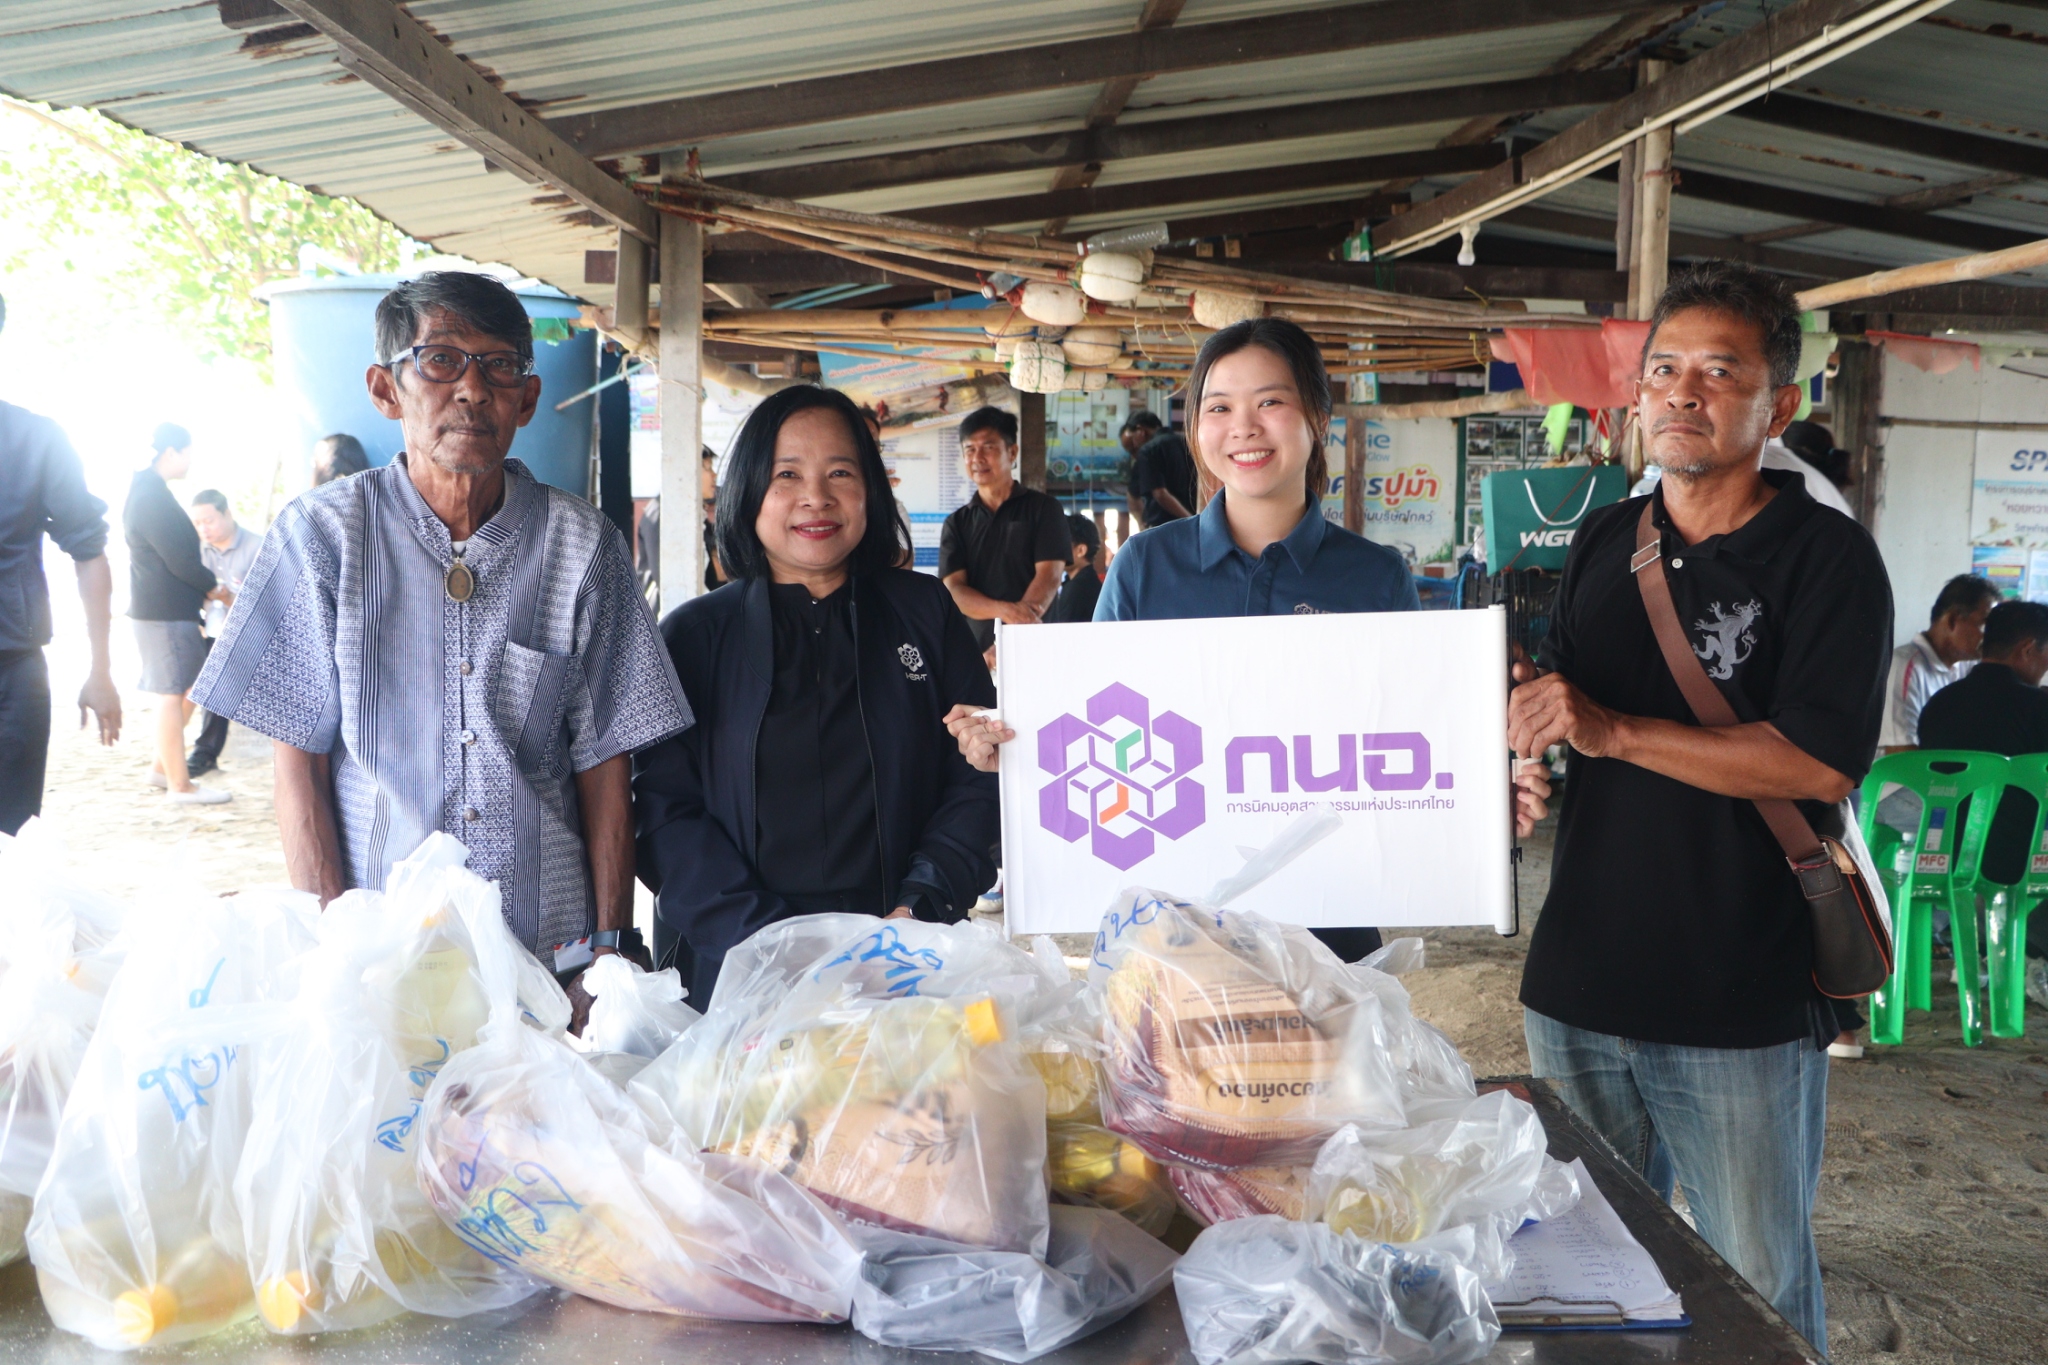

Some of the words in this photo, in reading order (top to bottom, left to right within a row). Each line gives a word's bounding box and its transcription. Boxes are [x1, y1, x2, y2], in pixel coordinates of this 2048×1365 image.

[2009, 449, 2048, 472] SP
[1224, 731, 1454, 794] กนอ.
[1918, 855, 1946, 866] MFC
